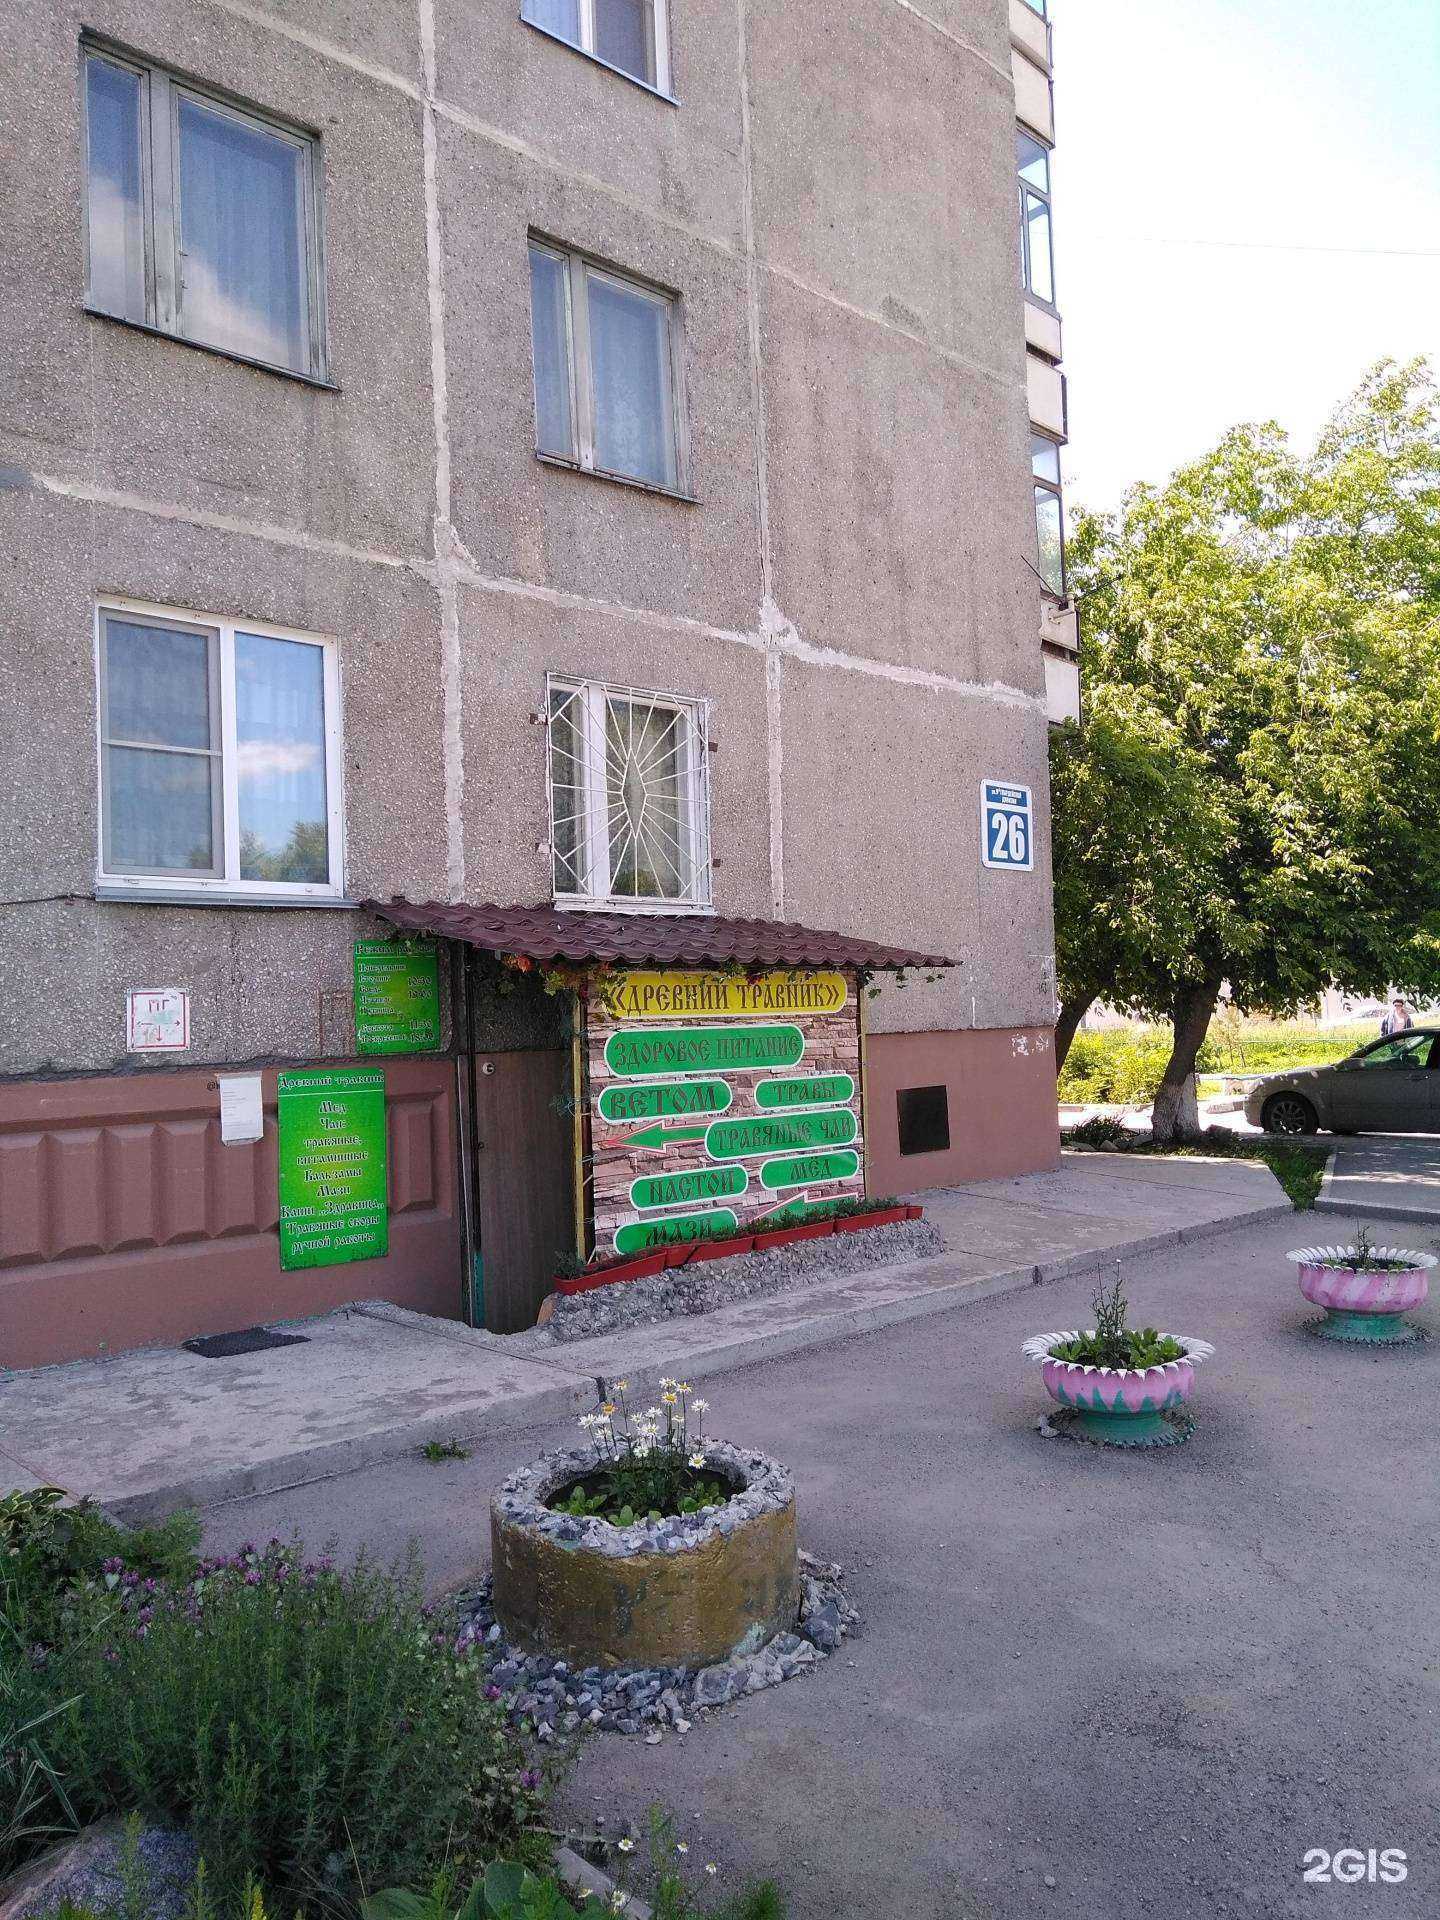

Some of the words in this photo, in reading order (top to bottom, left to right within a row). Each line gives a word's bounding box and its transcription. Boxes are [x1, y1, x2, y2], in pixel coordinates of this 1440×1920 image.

[991, 812, 1025, 861] 26
[614, 1039, 711, 1071] ЗДОРОВОЕ
[716, 1035, 800, 1060] ПИТАНИЕ
[611, 1086, 718, 1118] ВЕТОМ
[774, 1082, 836, 1103] ТРАВЫ
[714, 1120, 811, 1150] ТРАВЯНЫЕ
[820, 1118, 849, 1139] ЧАИ
[790, 1157, 833, 1181] МЁД
